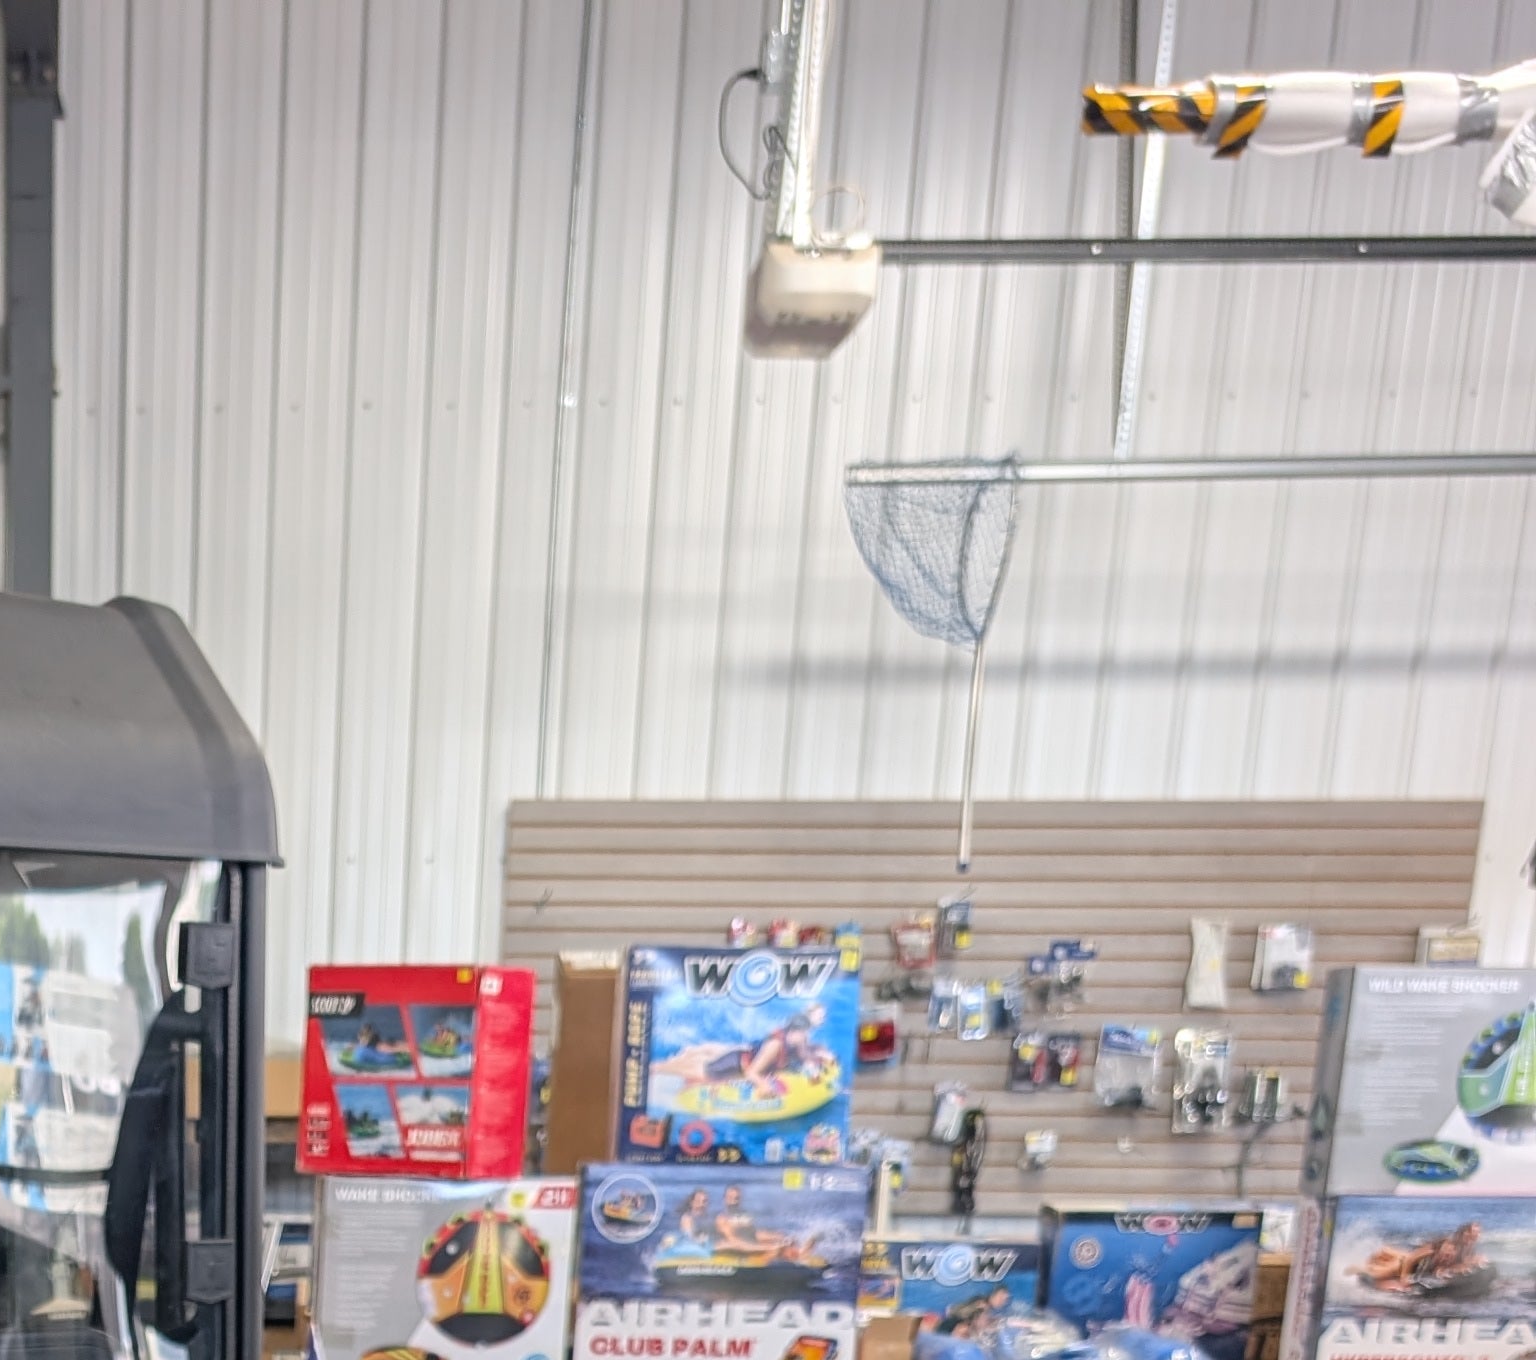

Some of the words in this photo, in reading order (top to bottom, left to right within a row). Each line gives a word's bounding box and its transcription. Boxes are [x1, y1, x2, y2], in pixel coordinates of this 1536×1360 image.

[683, 951, 838, 1007] WOW
[1114, 1213, 1214, 1236] WOW
[901, 1243, 1018, 1287] WOW
[585, 1300, 855, 1327] AIRHEAD
[589, 1336, 665, 1356] CLUB
[671, 1336, 751, 1357] PALM
